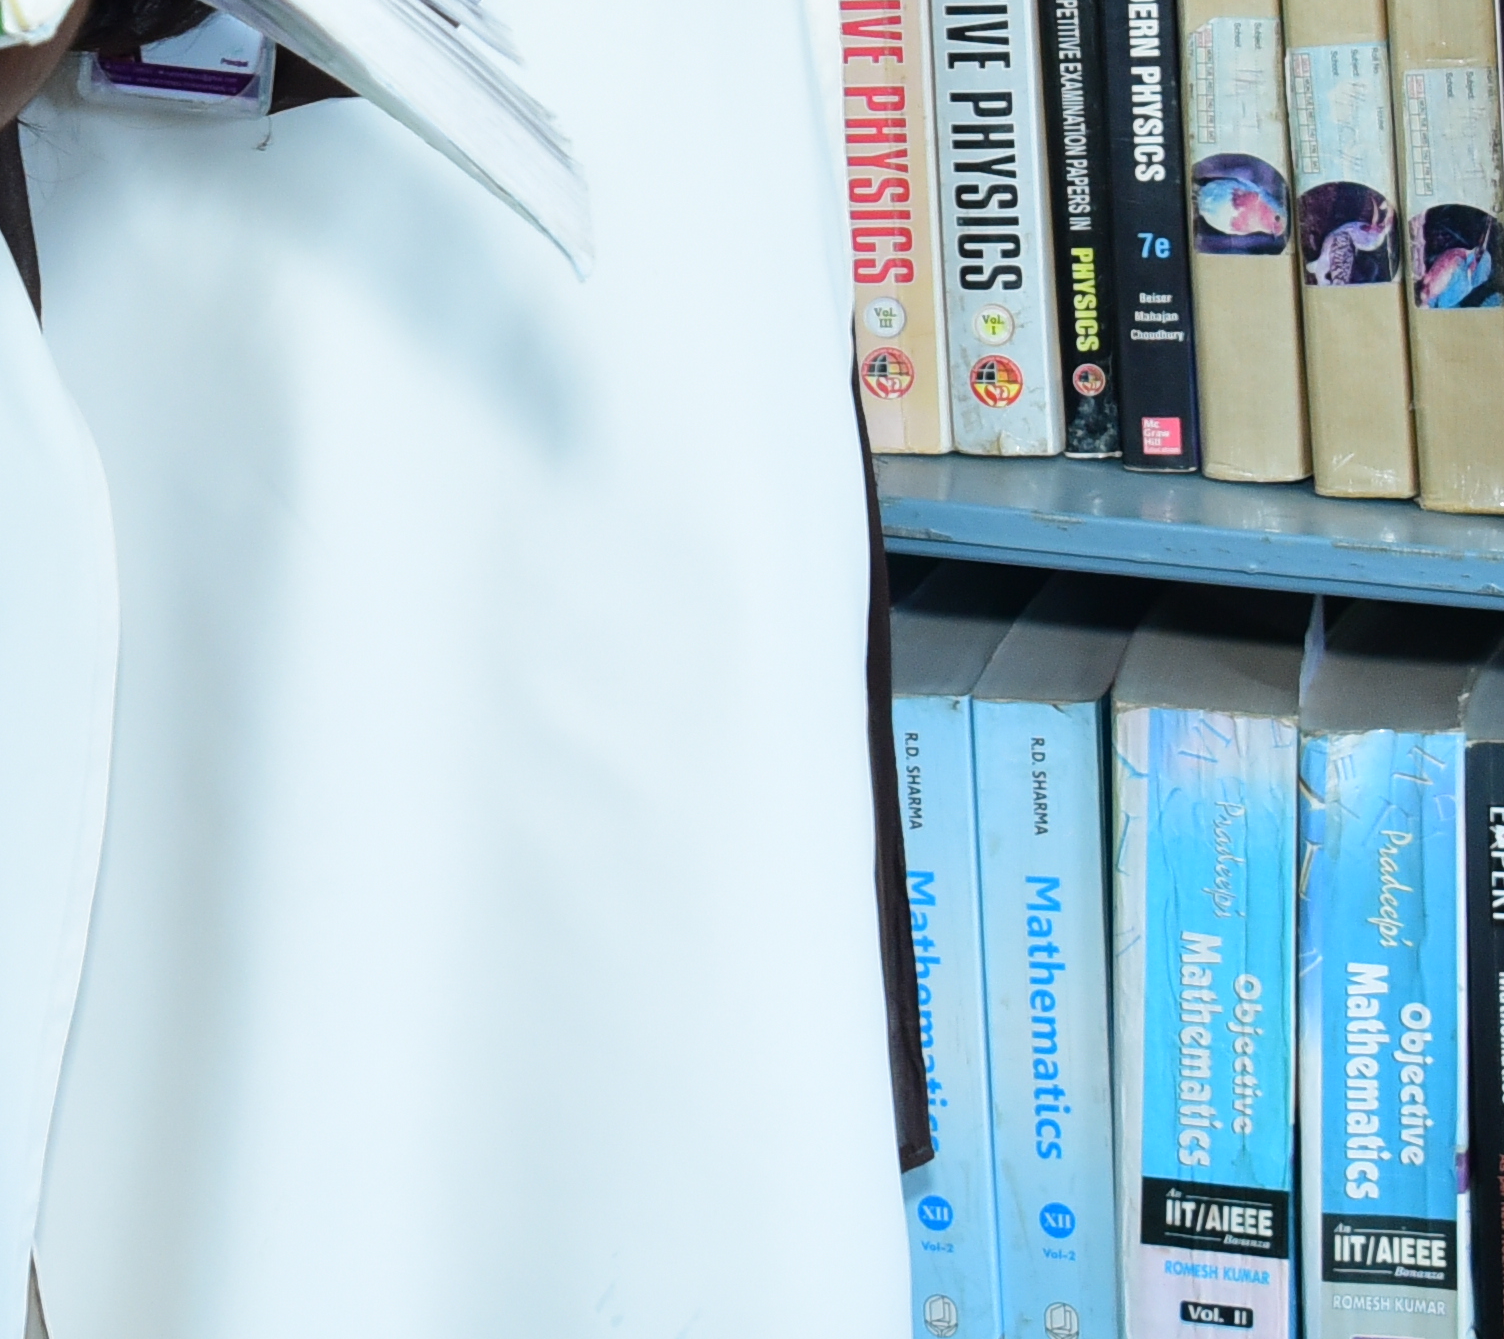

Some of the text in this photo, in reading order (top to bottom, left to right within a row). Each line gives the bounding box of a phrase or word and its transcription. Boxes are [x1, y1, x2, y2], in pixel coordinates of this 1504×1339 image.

[1059, 62, 1088, 157] EXAMINATION
[1130, 66, 1168, 183] PHYSICS
[844, 86, 914, 284] PHYSICS
[950, 91, 1023, 291] PHYSICS
[1065, 159, 1090, 215] PAPERS
[1138, 232, 1171, 258] 7e
[1070, 247, 1099, 352] PHYSICS
[1135, 311, 1179, 323] Mahajan
[1140, 293, 1172, 304] Beiser
[1131, 329, 1184, 341] Choudhury
[1032, 771, 1049, 836] SHARMA
[1025, 874, 1072, 1161] Mathematics
[1345, 961, 1393, 1201] Mathematics
[1400, 1003, 1433, 1167] Objective
[1042, 1248, 1077, 1261] Vol-2
[1334, 1235, 1447, 1267] IIT/AIEEE
[1188, 1305, 1225, 1324] Vol.
[1333, 1294, 1447, 1316] ROMESH KUMAR
